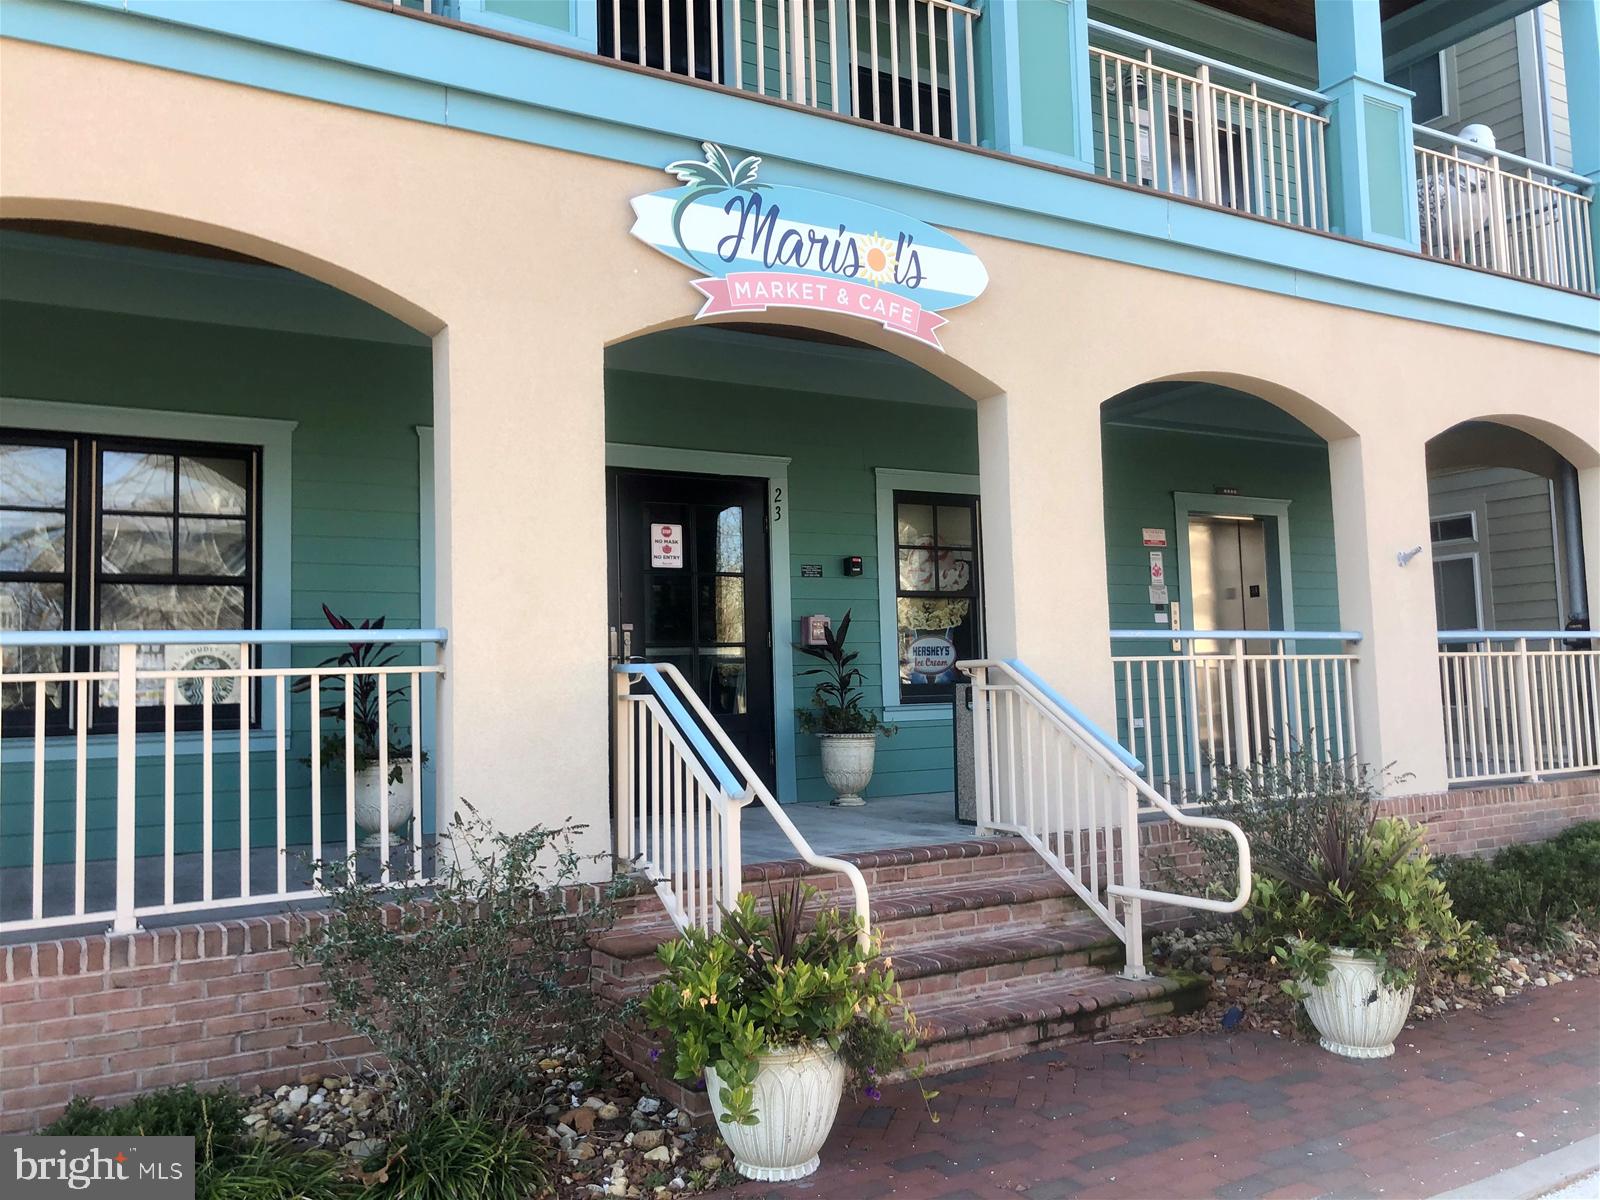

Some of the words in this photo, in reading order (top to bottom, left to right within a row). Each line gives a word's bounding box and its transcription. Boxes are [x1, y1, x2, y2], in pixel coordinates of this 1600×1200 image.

[717, 192, 927, 289] Marisol's
[734, 281, 828, 302] MARKET
[836, 288, 849, 306] &
[858, 293, 914, 325] CAFE
[912, 645, 950, 657] HERSHEY'S
[914, 656, 924, 667] Ice
[925, 657, 948, 667] Cream
